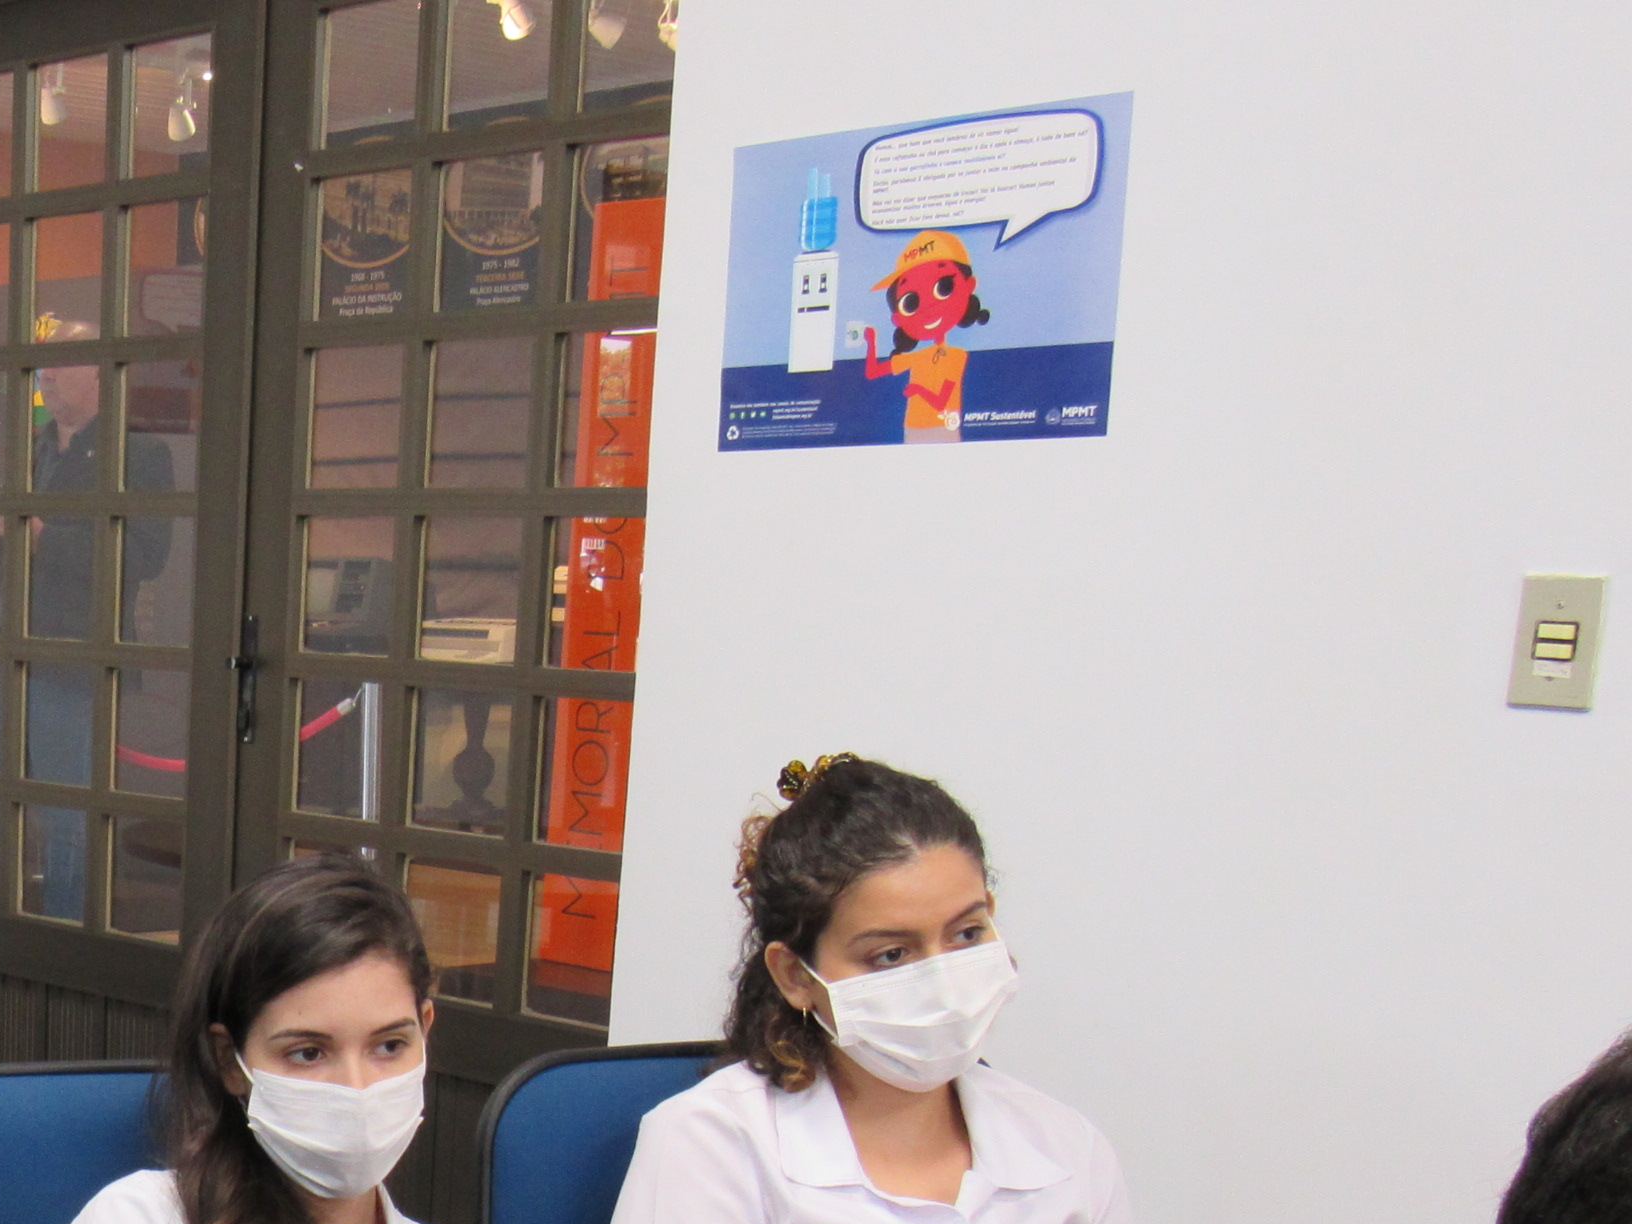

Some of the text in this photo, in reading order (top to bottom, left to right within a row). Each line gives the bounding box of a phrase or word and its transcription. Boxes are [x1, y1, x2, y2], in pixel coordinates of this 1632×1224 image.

[964, 411, 991, 422] MPMT
[1062, 405, 1098, 418] MPMT
[561, 610, 622, 920] MMORAL
[597, 254, 649, 457] MPT
